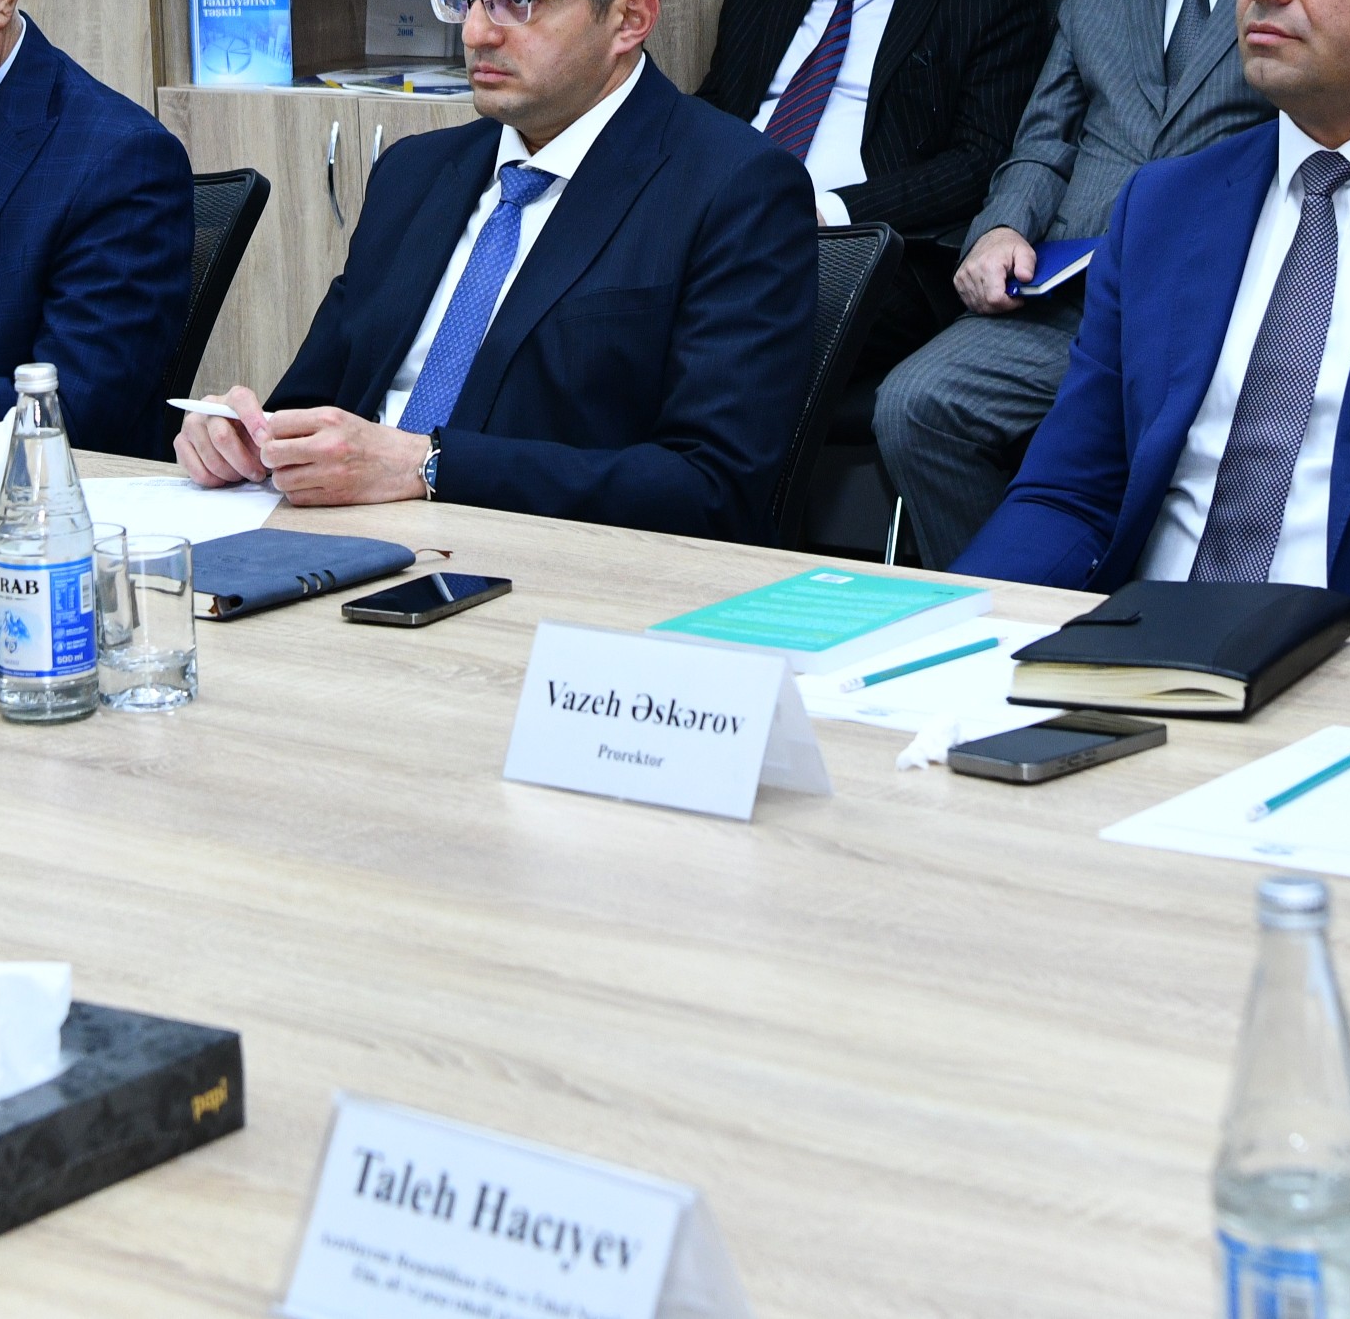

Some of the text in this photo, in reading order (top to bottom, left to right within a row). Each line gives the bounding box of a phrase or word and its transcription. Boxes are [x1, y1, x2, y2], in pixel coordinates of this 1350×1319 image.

[203, 7, 242, 18] TƏŞKİLİ
[74, 652, 84, 661] ml
[548, 680, 746, 736] Vazeh Əskərov
[597, 743, 665, 768] Prorektor
[354, 1145, 643, 1274] Taleh Hacıyev
